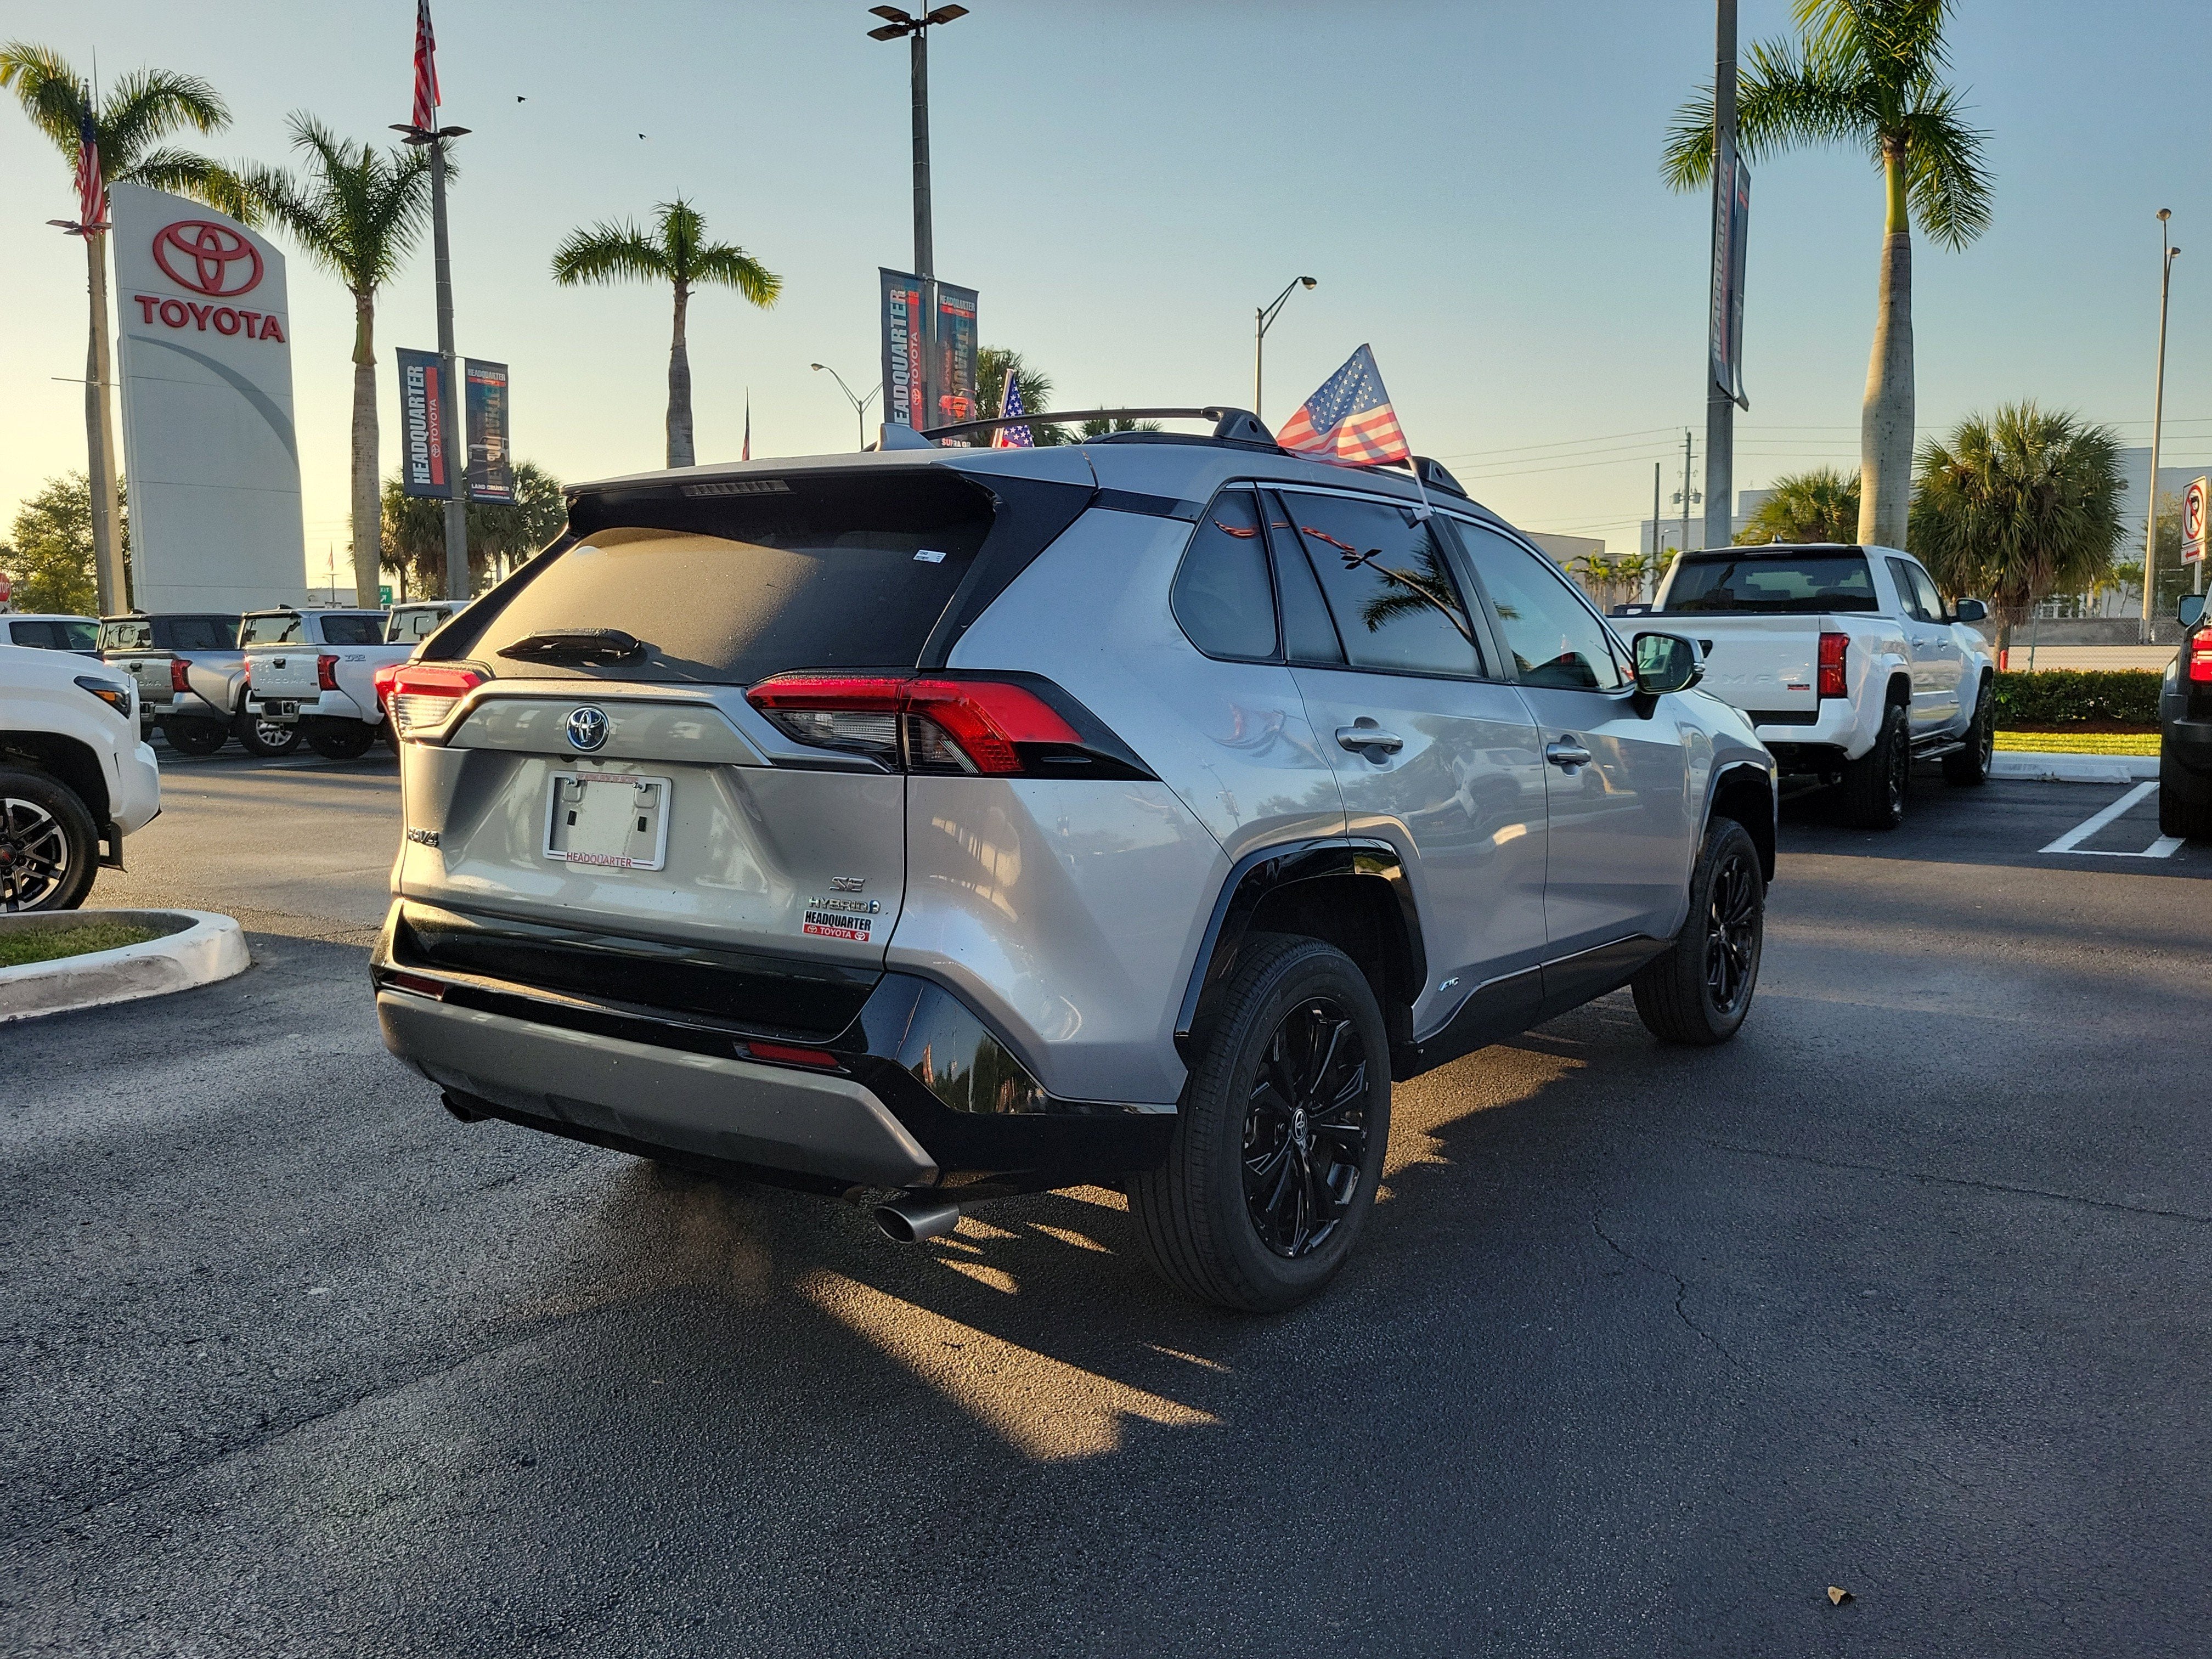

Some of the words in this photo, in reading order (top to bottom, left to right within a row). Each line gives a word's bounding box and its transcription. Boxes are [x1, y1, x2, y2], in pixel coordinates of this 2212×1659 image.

[135, 295, 286, 343] TOYOTA
[890, 289, 911, 425] EADQUARTER
[911, 332, 920, 386] TOYOTA
[407, 365, 431, 484] HEADQUARTER
[429, 399, 439, 443] TOYOTA
[566, 851, 631, 867] HEADQUARTER
[828, 876, 866, 892] SE
[809, 896, 868, 913] HYBRID
[805, 911, 871, 931] HEADQUARTER
[820, 927, 851, 939] TOYOTA
